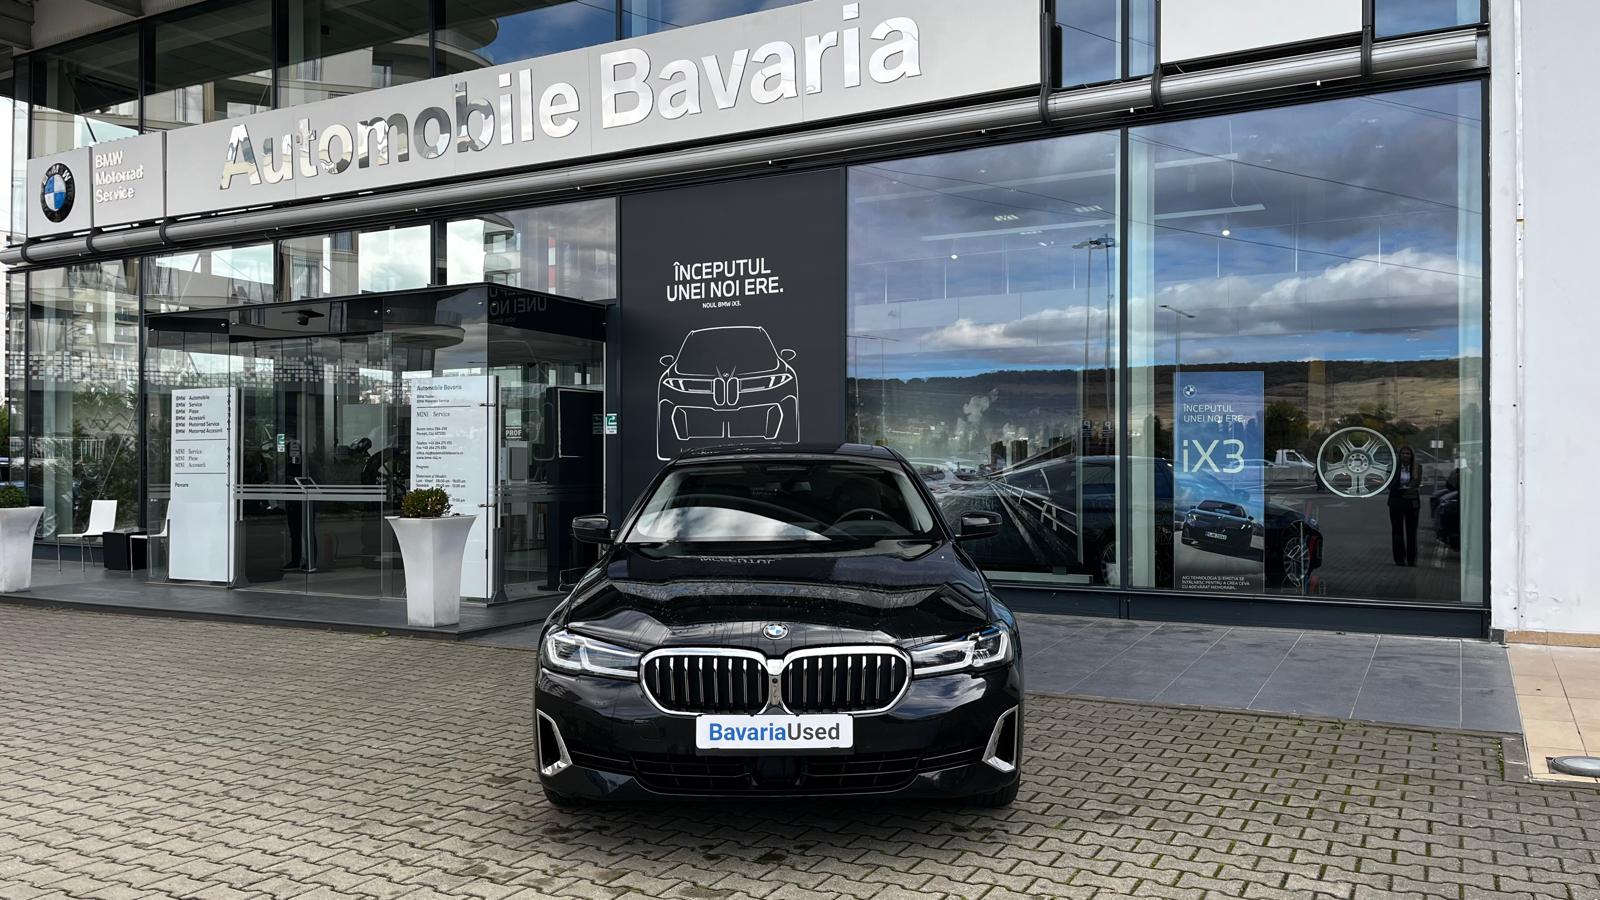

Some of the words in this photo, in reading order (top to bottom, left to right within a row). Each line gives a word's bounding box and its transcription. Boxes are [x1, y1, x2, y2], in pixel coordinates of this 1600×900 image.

[219, 68, 580, 190] Automobile
[599, 2, 922, 129] Bavaria
[95, 150, 123, 169] BMW
[95, 165, 144, 186] Motorrad
[95, 186, 135, 203] Service
[673, 257, 771, 281] ÎNCEPUTUL
[666, 282, 705, 302] UNEI
[710, 279, 740, 298] NOI
[744, 276, 784, 295] ERE.
[1183, 402, 1234, 413] ÎNCEPUTUL
[1183, 415, 1204, 423] UNEI
[1207, 415, 1223, 423] NOI
[1183, 439, 1245, 474] iX3
[708, 722, 841, 741] BavariaUsed
